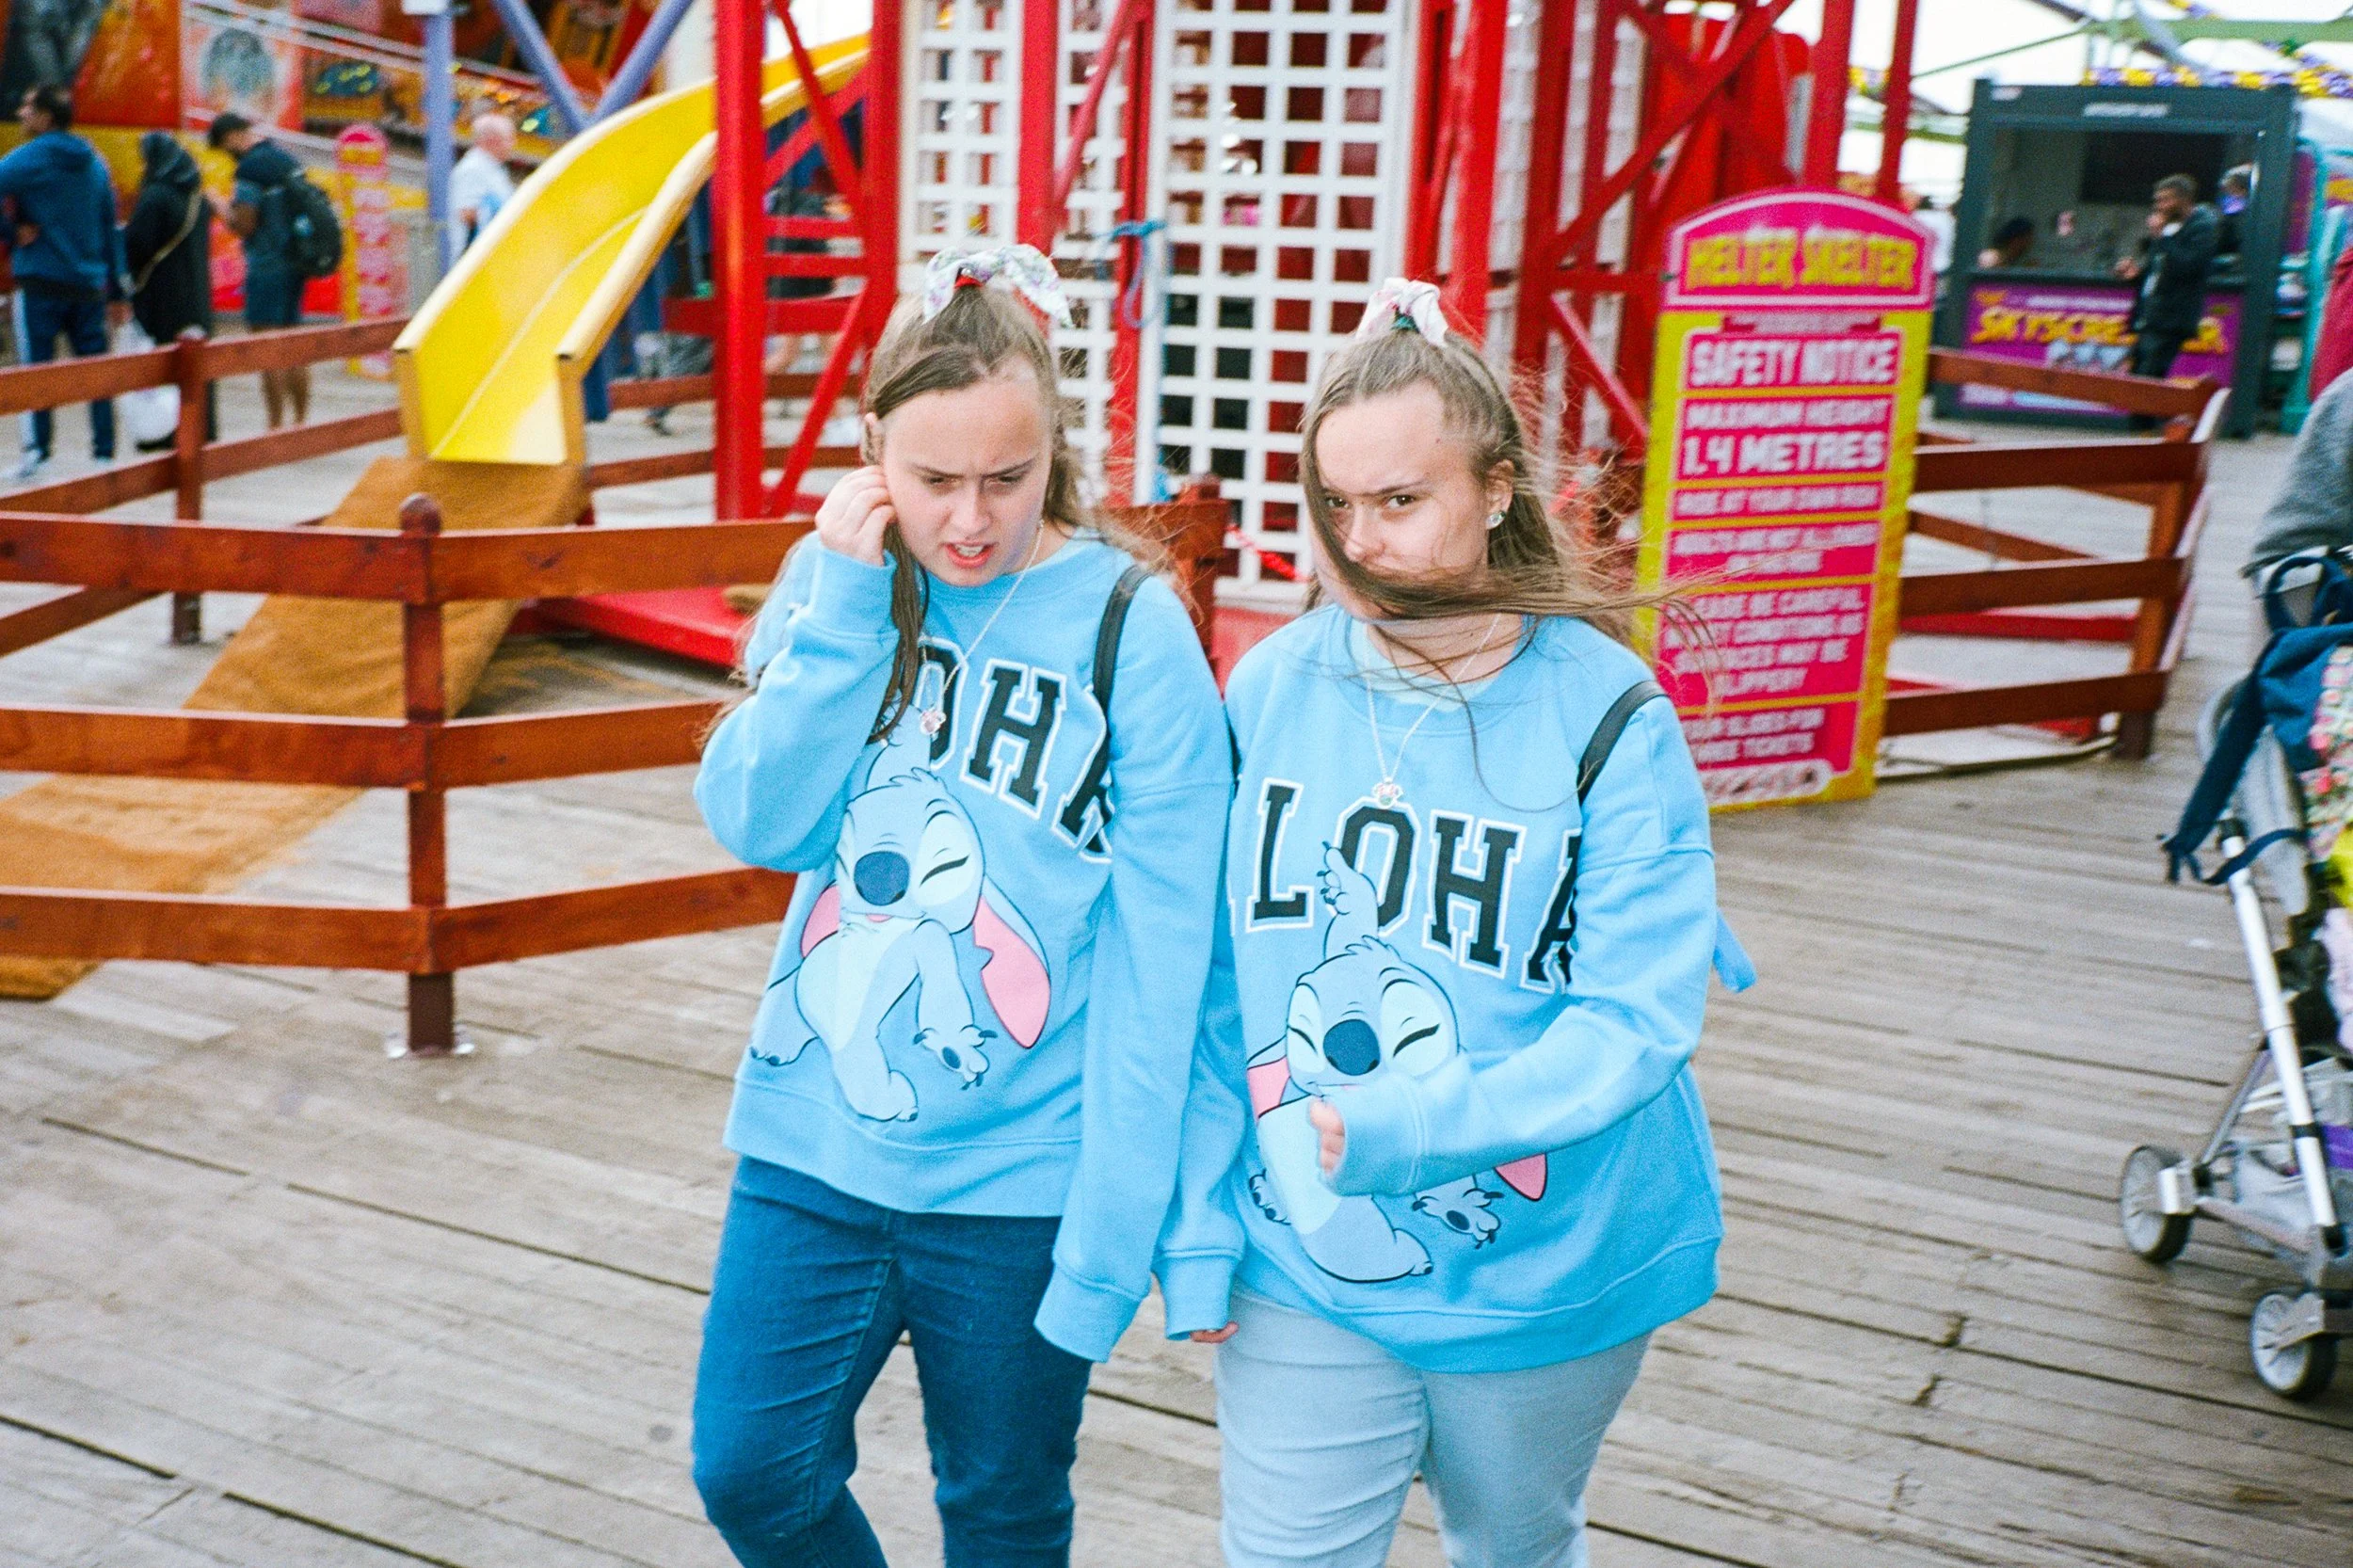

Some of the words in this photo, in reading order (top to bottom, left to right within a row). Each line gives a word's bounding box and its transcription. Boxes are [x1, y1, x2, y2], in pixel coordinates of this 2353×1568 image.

[1690, 340, 1801, 387] SAFETY
[1799, 339, 1897, 384] NOTICE
[1738, 431, 1884, 472] METRES
[911, 634, 1118, 864] OHA
[1226, 776, 1584, 996] LOHA
